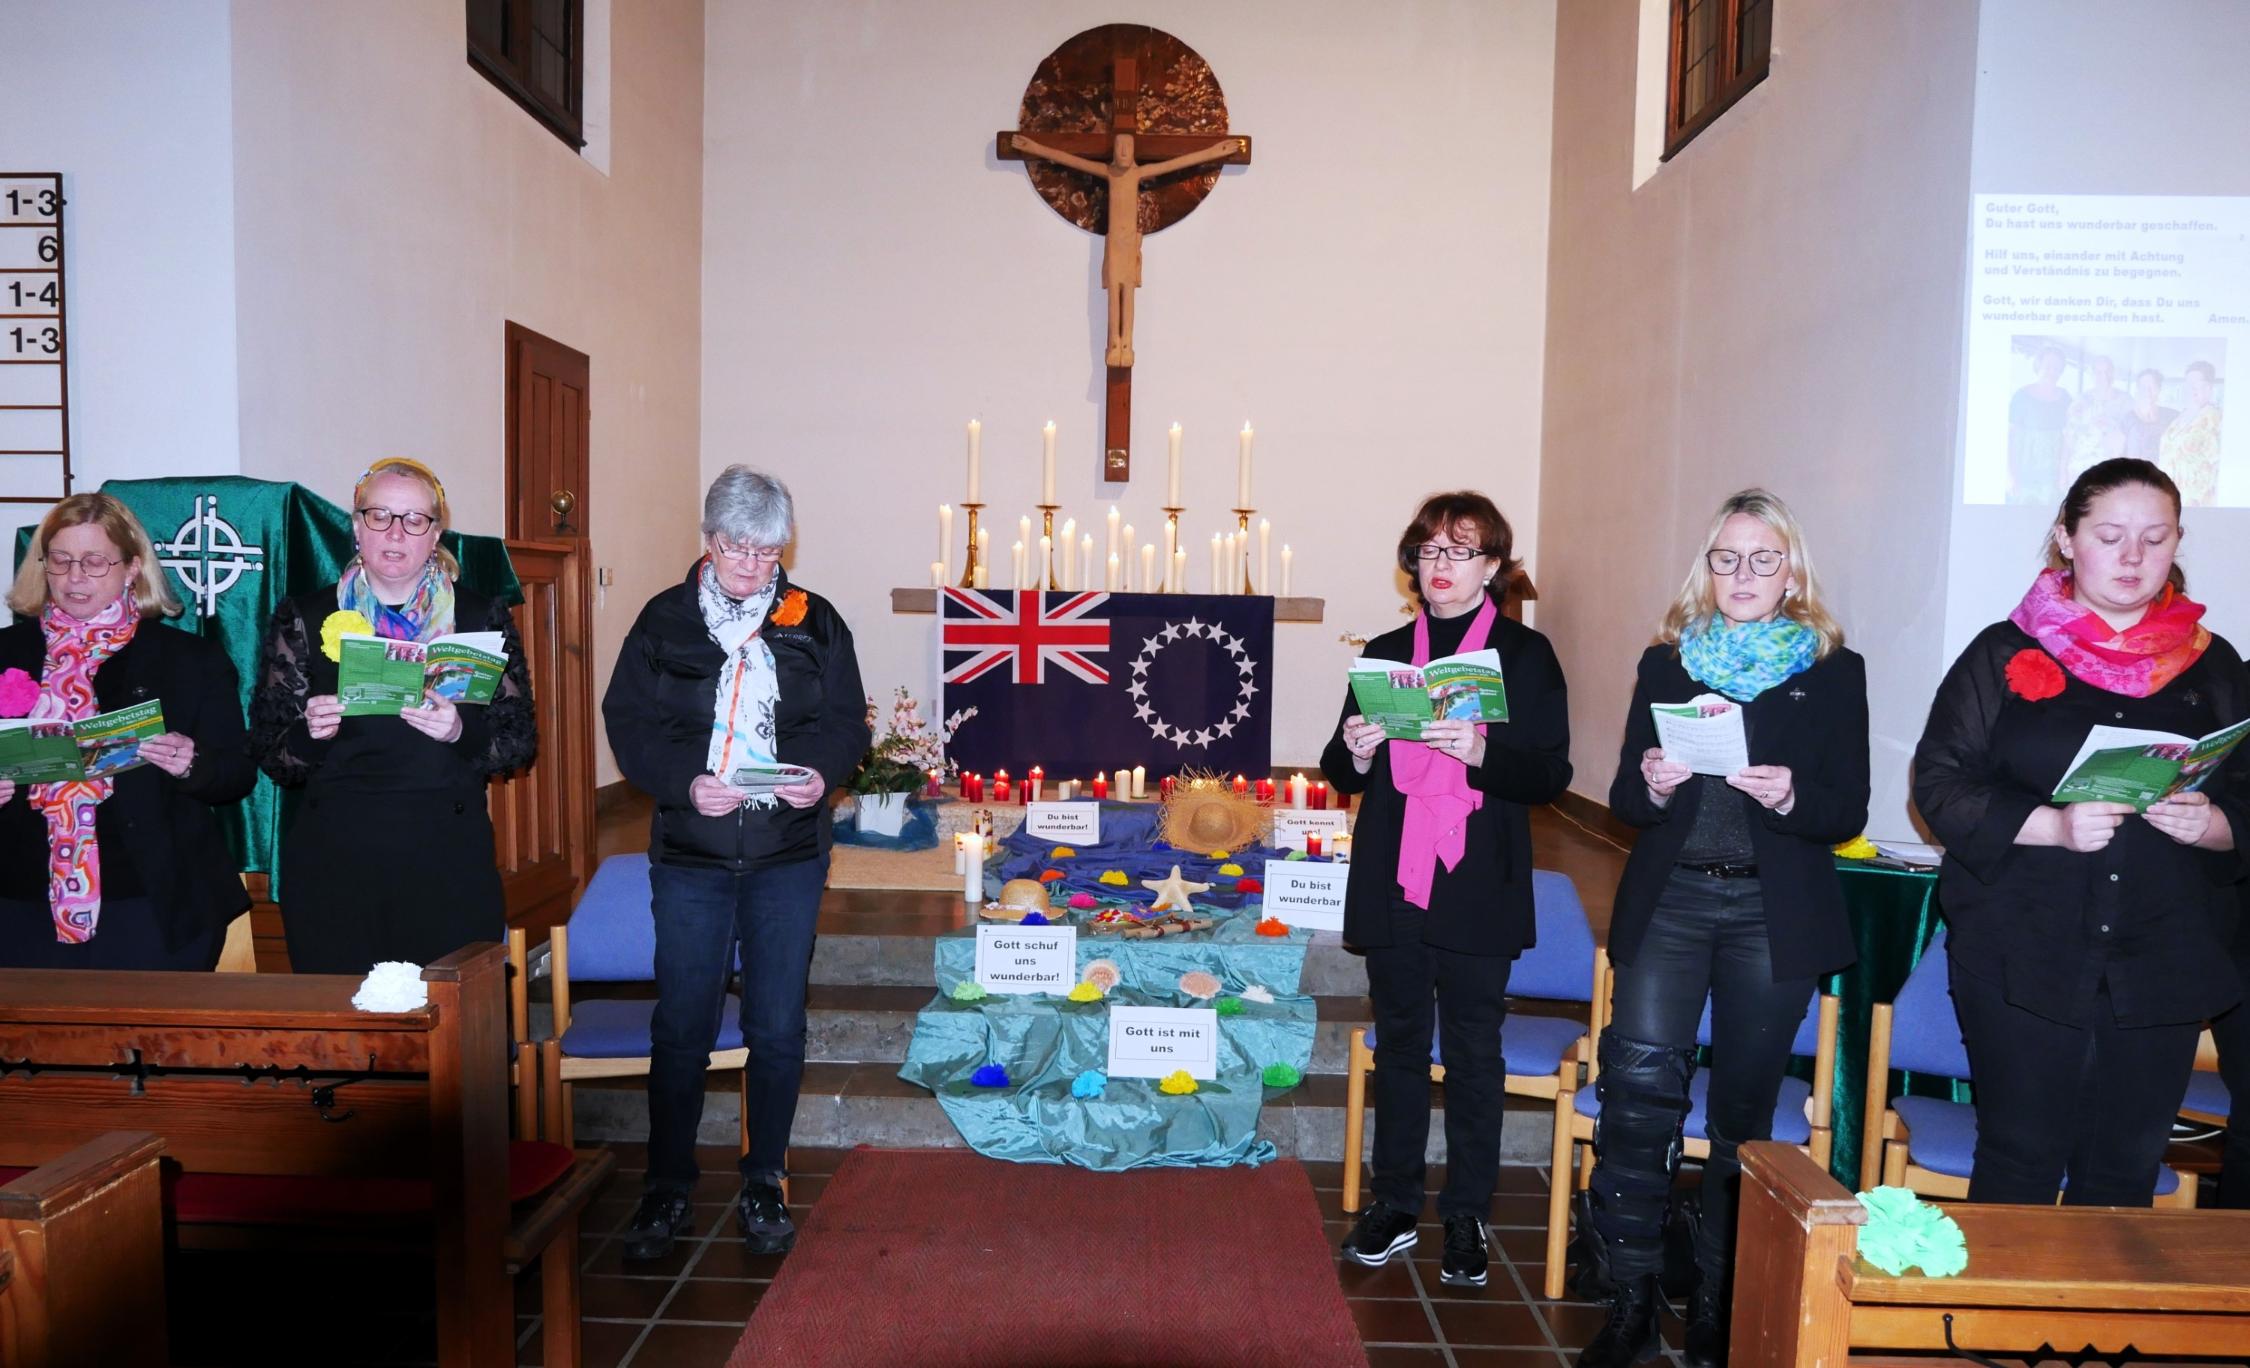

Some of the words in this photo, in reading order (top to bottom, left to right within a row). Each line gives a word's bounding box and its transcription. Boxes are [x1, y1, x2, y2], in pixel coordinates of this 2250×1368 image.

[5, 189, 57, 216] 1-3
[1985, 202, 2022, 213] Guter
[2026, 203, 2059, 216] Gott,
[1985, 217, 2002, 228] Du
[2006, 218, 2035, 229] hast
[2039, 221, 2062, 229] uns
[2066, 219, 2136, 230] wunderbar
[2140, 219, 2218, 232] geschaffen.
[37, 235, 57, 262] 6
[1984, 249, 2007, 259] Hilf
[2012, 252, 2039, 263] uns,
[2043, 250, 2100, 260] einander
[2104, 250, 2125, 261] mit
[2130, 251, 2184, 264] Achtung
[1984, 265, 2008, 275] und
[2012, 265, 2090, 276] Verständnis
[2094, 268, 2109, 277] zu
[2113, 266, 2182, 279] begegnen.
[8, 281, 59, 307] 1-4
[1983, 294, 2015, 308] Gott,
[2020, 295, 2040, 305] wir
[2044, 296, 2091, 306] danken
[2096, 296, 2117, 308] Dir,
[2121, 296, 2152, 307] dass
[2156, 297, 2173, 307] Du
[2177, 299, 2200, 308] uns
[1982, 311, 2052, 321] wunderbar
[2056, 311, 2128, 324] geschaffen
[2132, 312, 2165, 323] hast.
[2207, 313, 2249, 324] Amen.
[10, 327, 60, 353] 1-3
[432, 645, 504, 666] Weltgebetstag
[1429, 664, 1497, 677] Weltgebetstag
[79, 705, 157, 731] Weltgebetstag
[1290, 879, 1306, 889] Du
[1310, 880, 1332, 891] bist
[1279, 895, 1342, 907] wunderbar
[993, 940, 1020, 951] Gott
[1024, 940, 1058, 951] schuf
[1014, 957, 1036, 966] uns
[989, 970, 1060, 982] wunderbar!
[1125, 1026, 1154, 1038] Gott
[1158, 1026, 1175, 1038] ist
[1178, 1027, 1200, 1039] mit
[1150, 1044, 1173, 1054] uns
